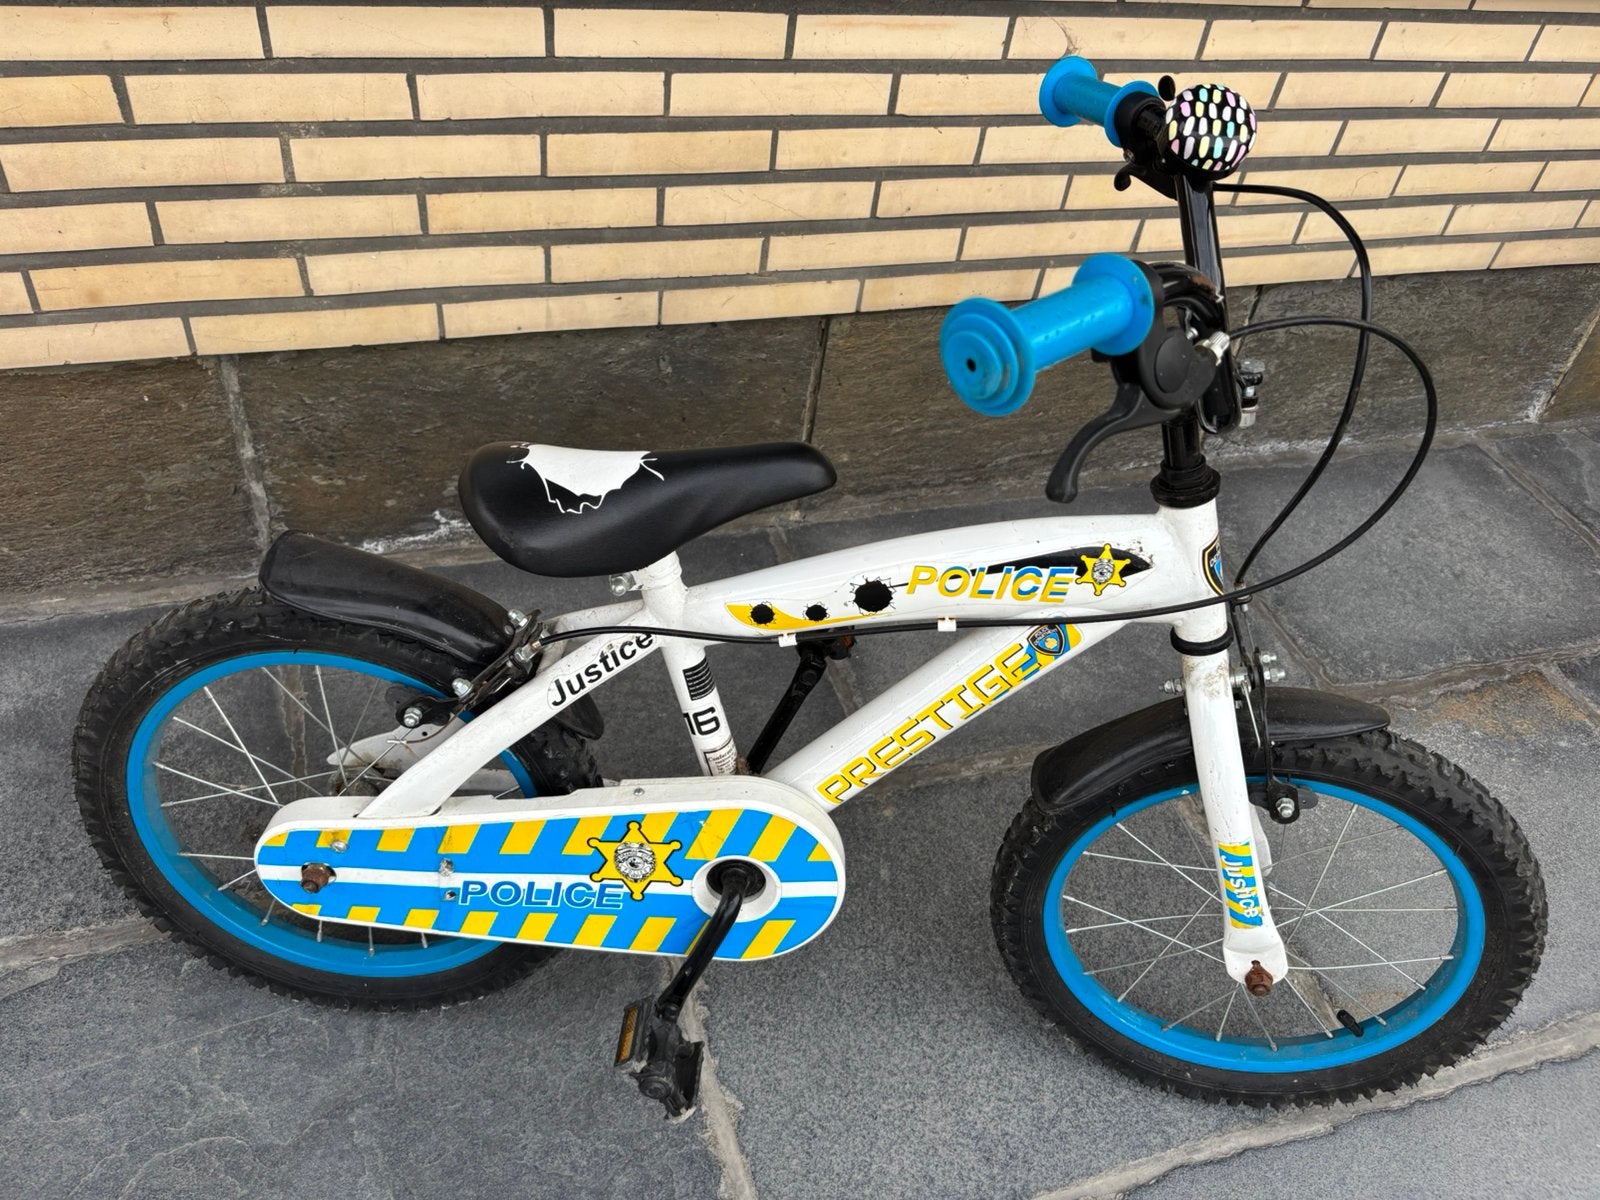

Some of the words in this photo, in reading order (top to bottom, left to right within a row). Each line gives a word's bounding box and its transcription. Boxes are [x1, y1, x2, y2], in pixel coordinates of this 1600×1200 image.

[906, 564, 1075, 604] POLICE
[551, 633, 654, 707] Justice
[683, 706, 720, 736] 16
[816, 643, 1042, 804] PRESTIGE
[458, 880, 624, 909] POLICE
